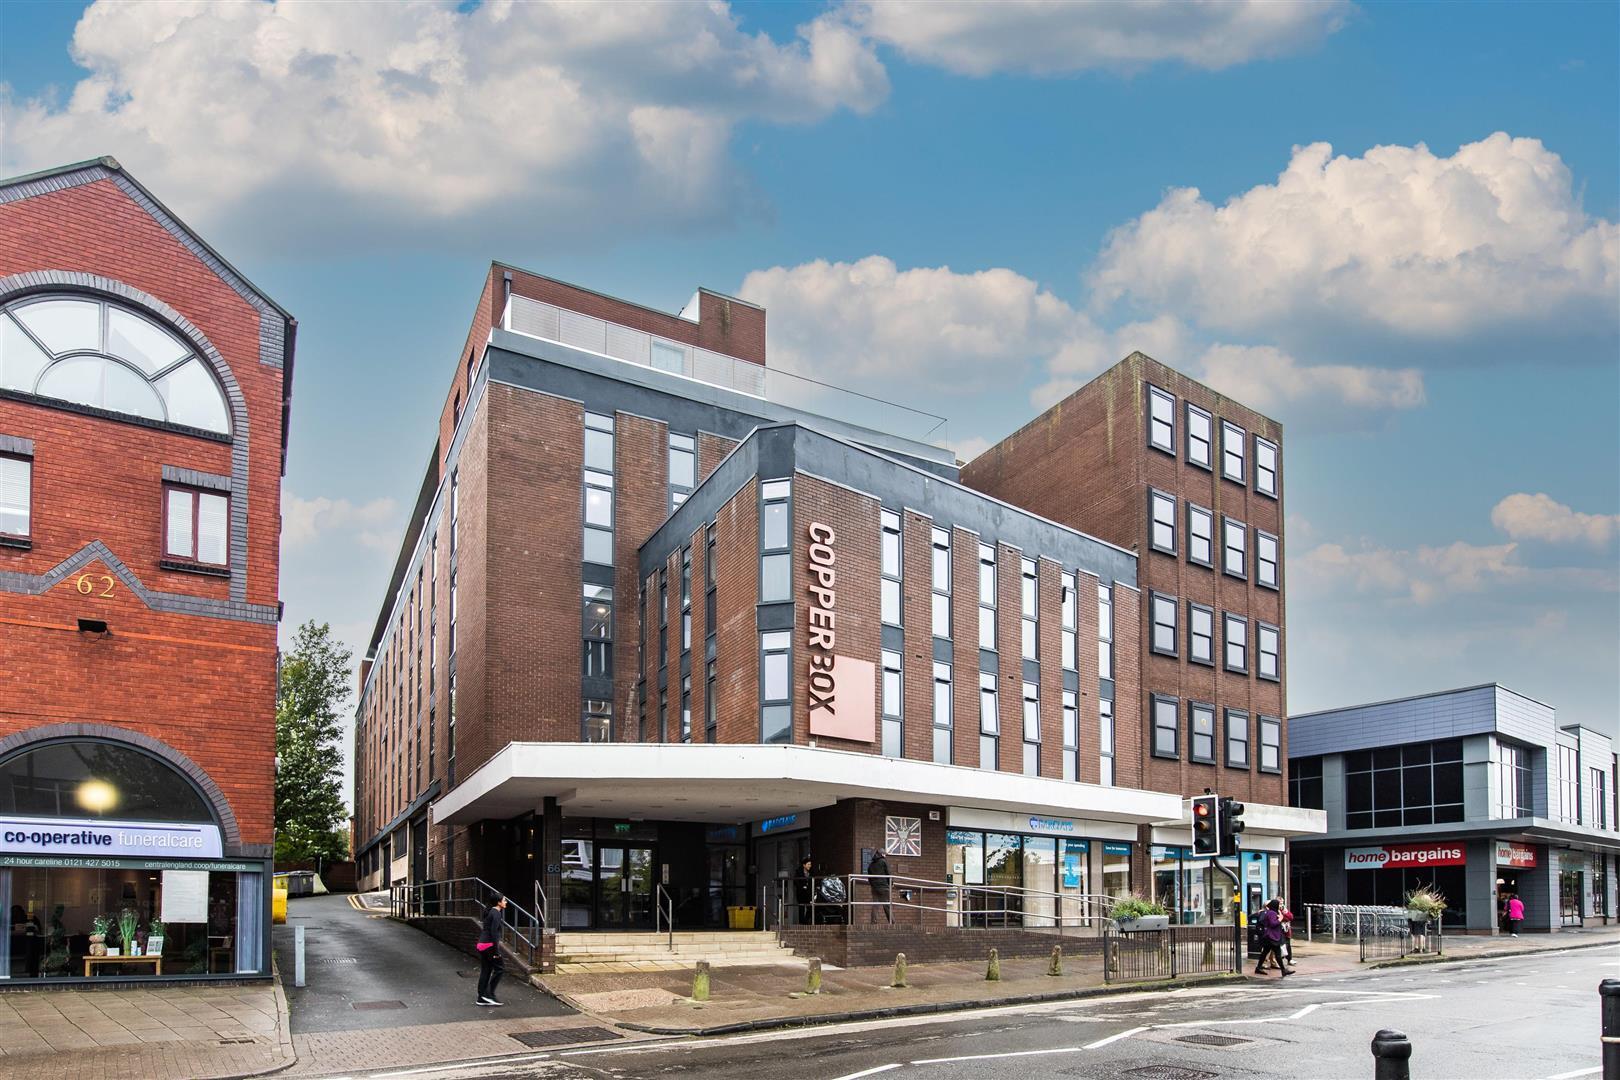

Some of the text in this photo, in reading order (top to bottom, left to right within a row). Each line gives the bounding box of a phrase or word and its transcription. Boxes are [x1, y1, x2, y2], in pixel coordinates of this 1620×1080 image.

[77, 573, 115, 598] 62
[809, 521, 836, 716] COPPER BOX
[4, 830, 203, 848] co-operative funeralcare
[4, 857, 121, 868] 24 hour careline 0121 427 5015
[1348, 847, 1462, 863] home bargains
[1512, 848, 1534, 862] bargains
[144, 861, 247, 871] centralengland.coop/funeralcare
